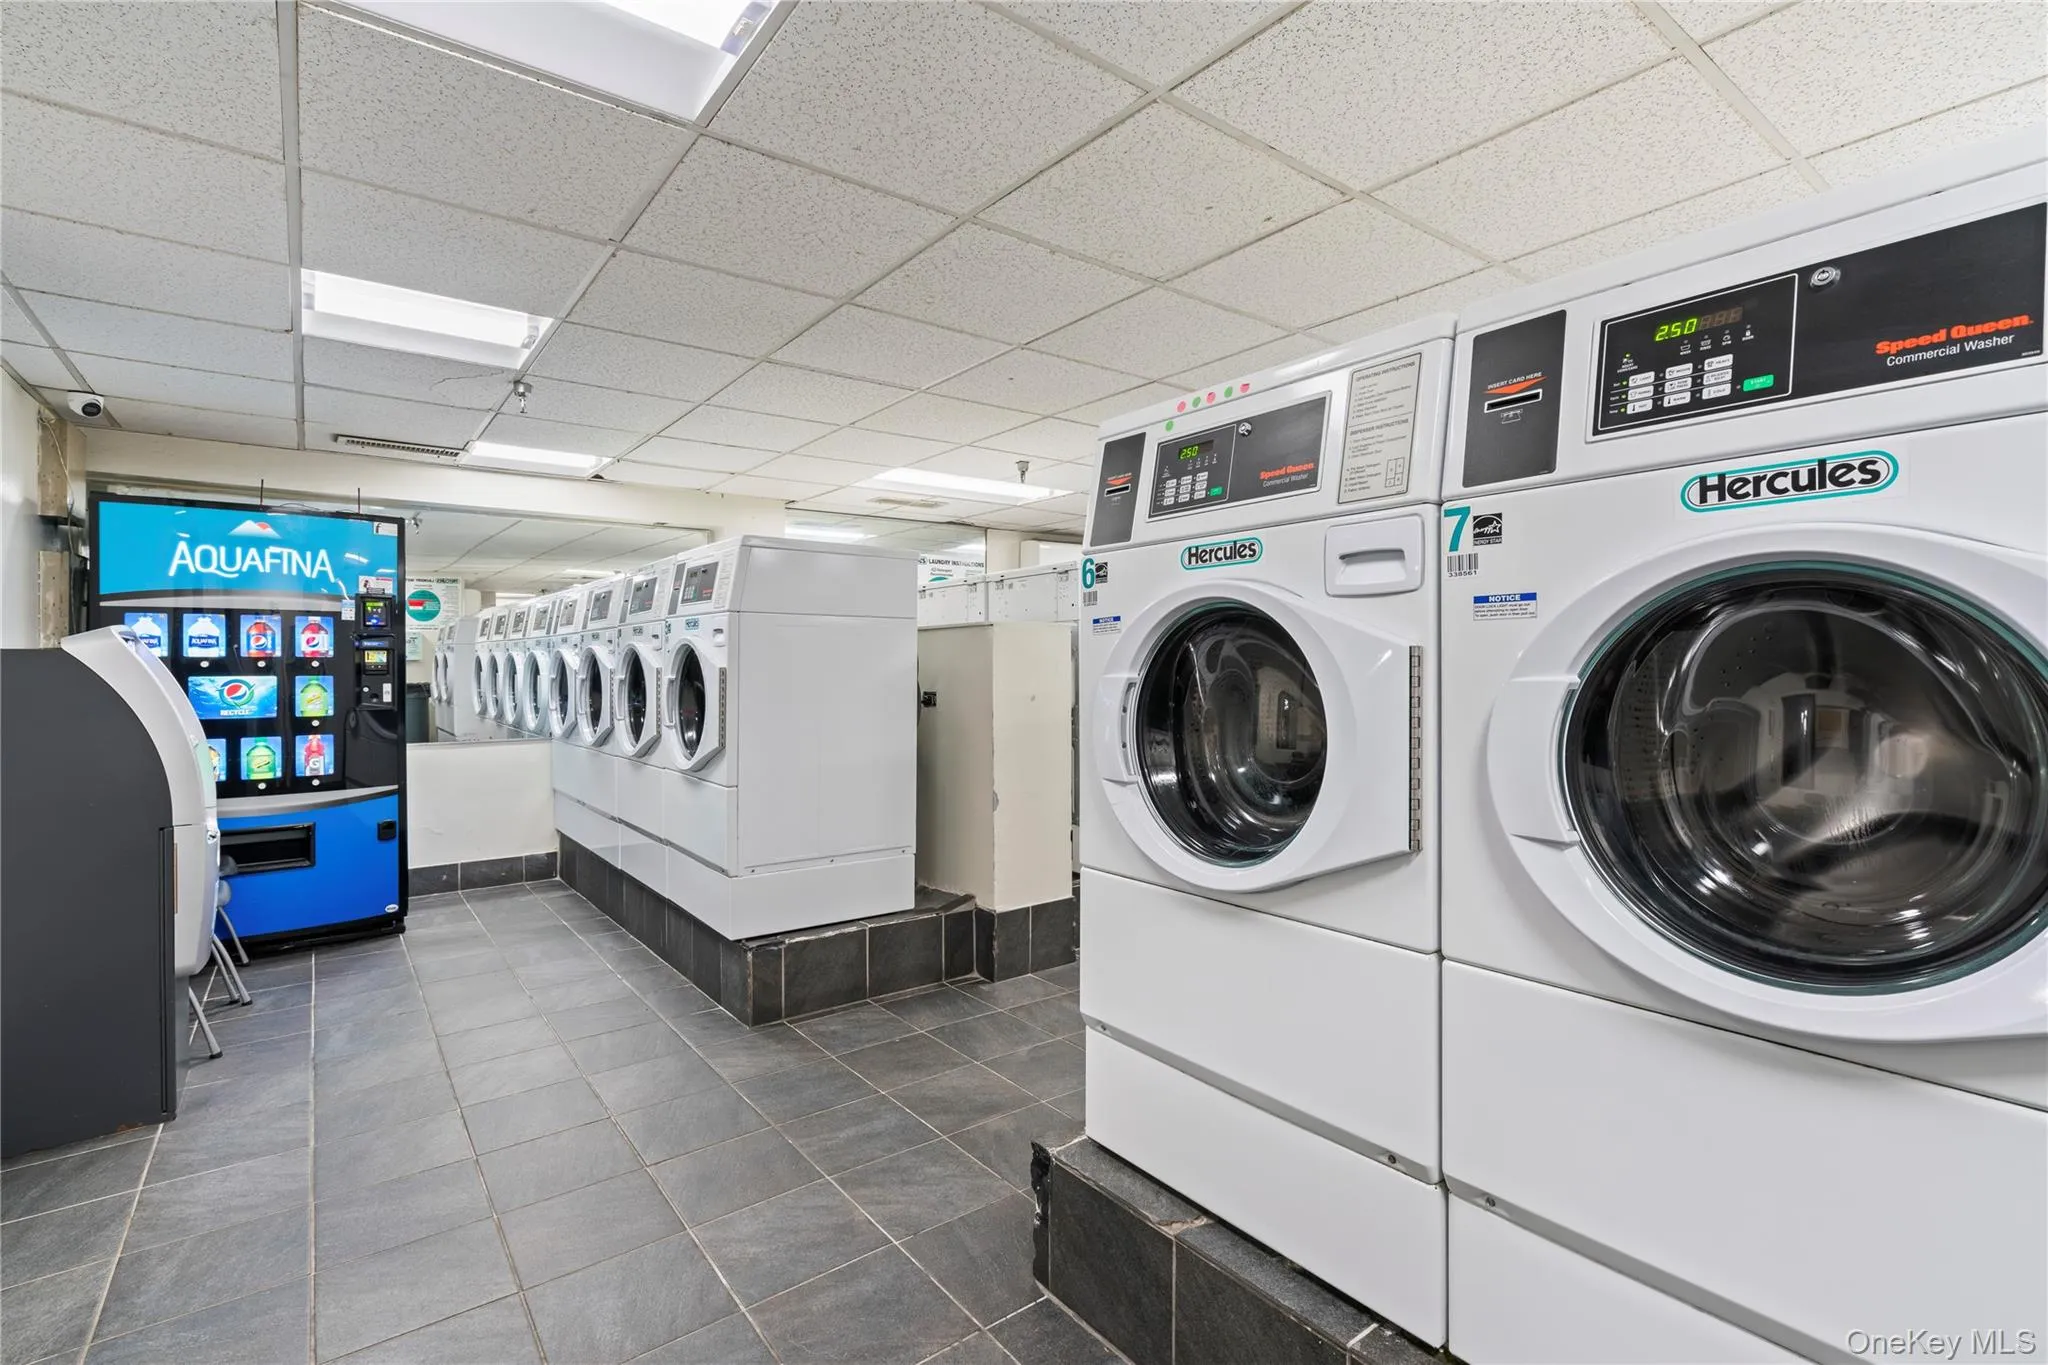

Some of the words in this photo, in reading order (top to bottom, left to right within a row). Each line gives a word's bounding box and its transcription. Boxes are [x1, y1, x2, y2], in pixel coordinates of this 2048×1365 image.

[1875, 328, 1947, 355] Speed
[1950, 314, 2030, 340] Queen
[1886, 344, 1960, 367] Commercial
[1964, 334, 2016, 352] Washer
[1488, 380, 1508, 390] INSERT
[1508, 376, 1525, 384] CARD
[1699, 458, 1882, 504] Hercules
[1444, 506, 1471, 552] 7
[1188, 541, 1256, 565] Hercules
[1082, 558, 1095, 589] 6
